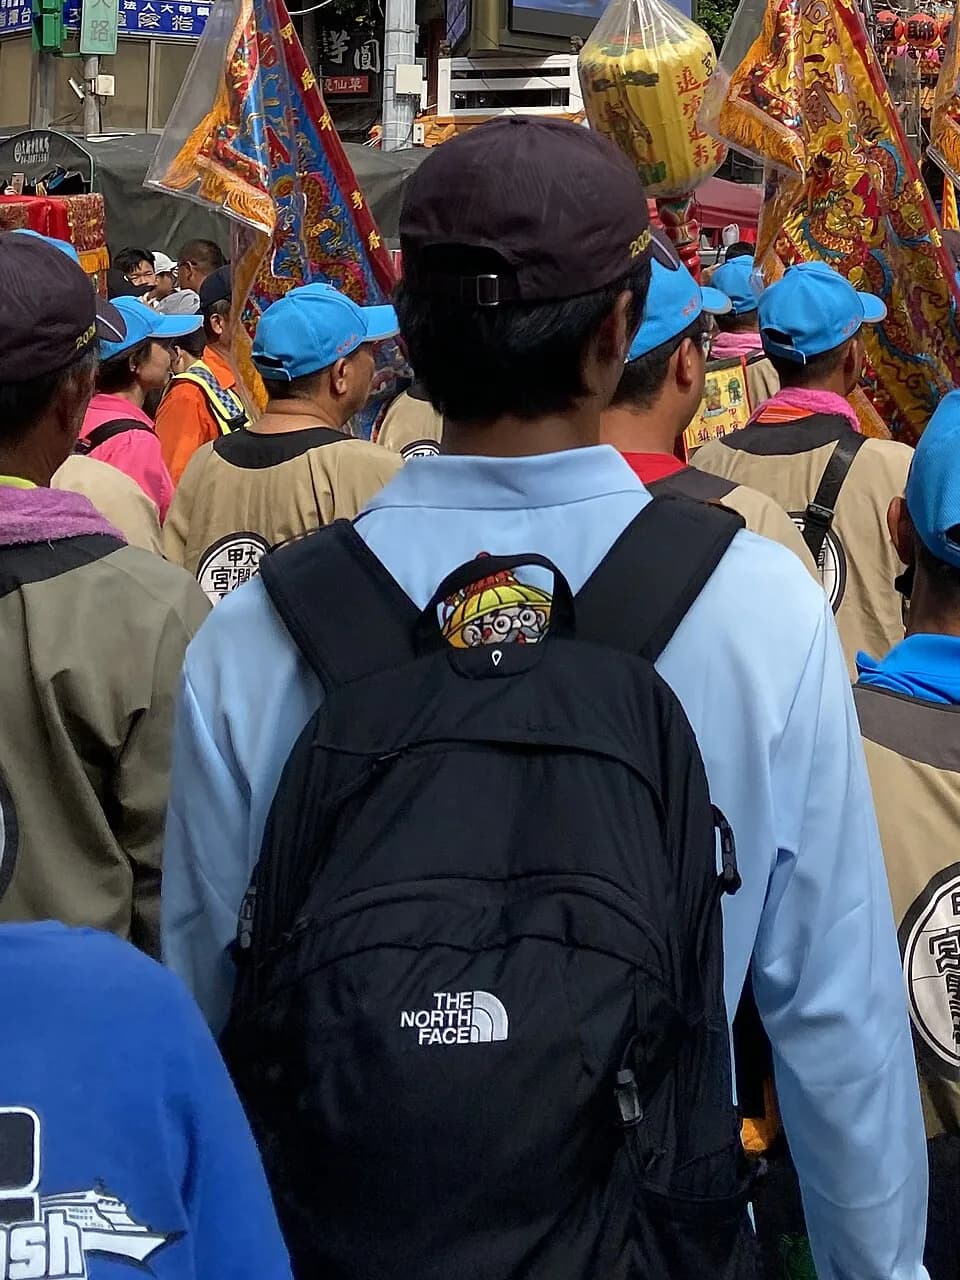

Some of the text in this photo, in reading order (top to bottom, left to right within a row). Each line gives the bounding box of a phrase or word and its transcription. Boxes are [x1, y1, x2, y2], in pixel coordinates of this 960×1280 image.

[326, 28, 381, 74] 芋圓
[227, 546, 258, 567] 大甲
[211, 566, 260, 591] 瀾宮
[433, 991, 473, 1010] THE
[400, 1009, 471, 1028] NORTH
[418, 1027, 471, 1045] FACE
[0, 1209, 85, 1280] sh
